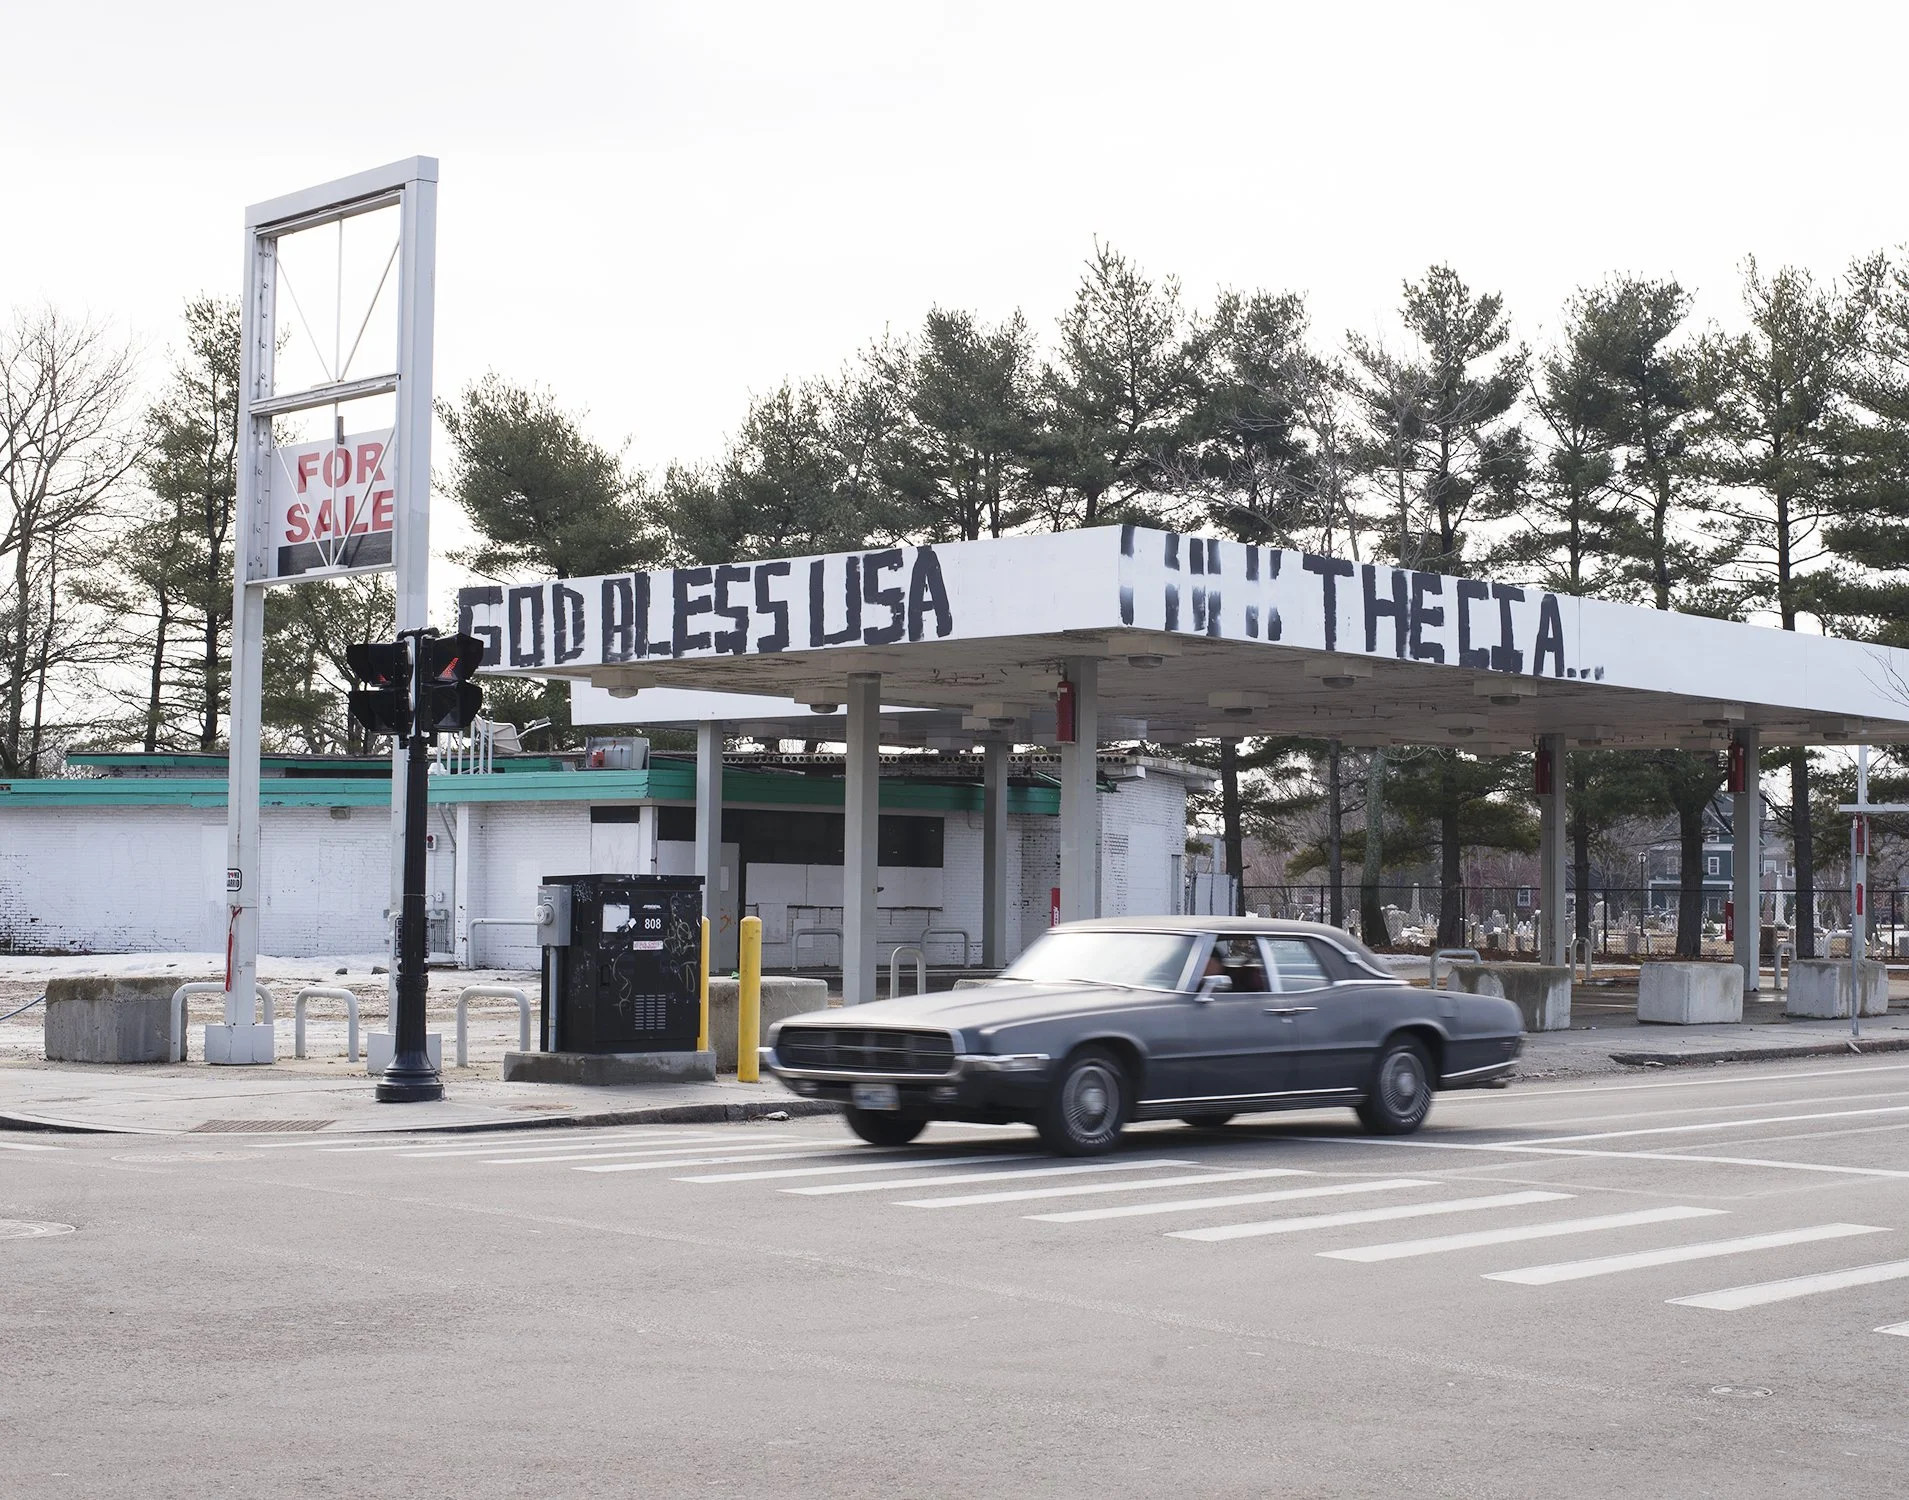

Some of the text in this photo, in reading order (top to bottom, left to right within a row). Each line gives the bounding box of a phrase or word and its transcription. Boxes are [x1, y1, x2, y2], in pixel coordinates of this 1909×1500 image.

[297, 442, 386, 494] FOR
[285, 489, 394, 543] SALE
[458, 544, 953, 668] GOD BLESS USA
[1302, 553, 1445, 664] THE
[644, 918, 662, 930] 808
